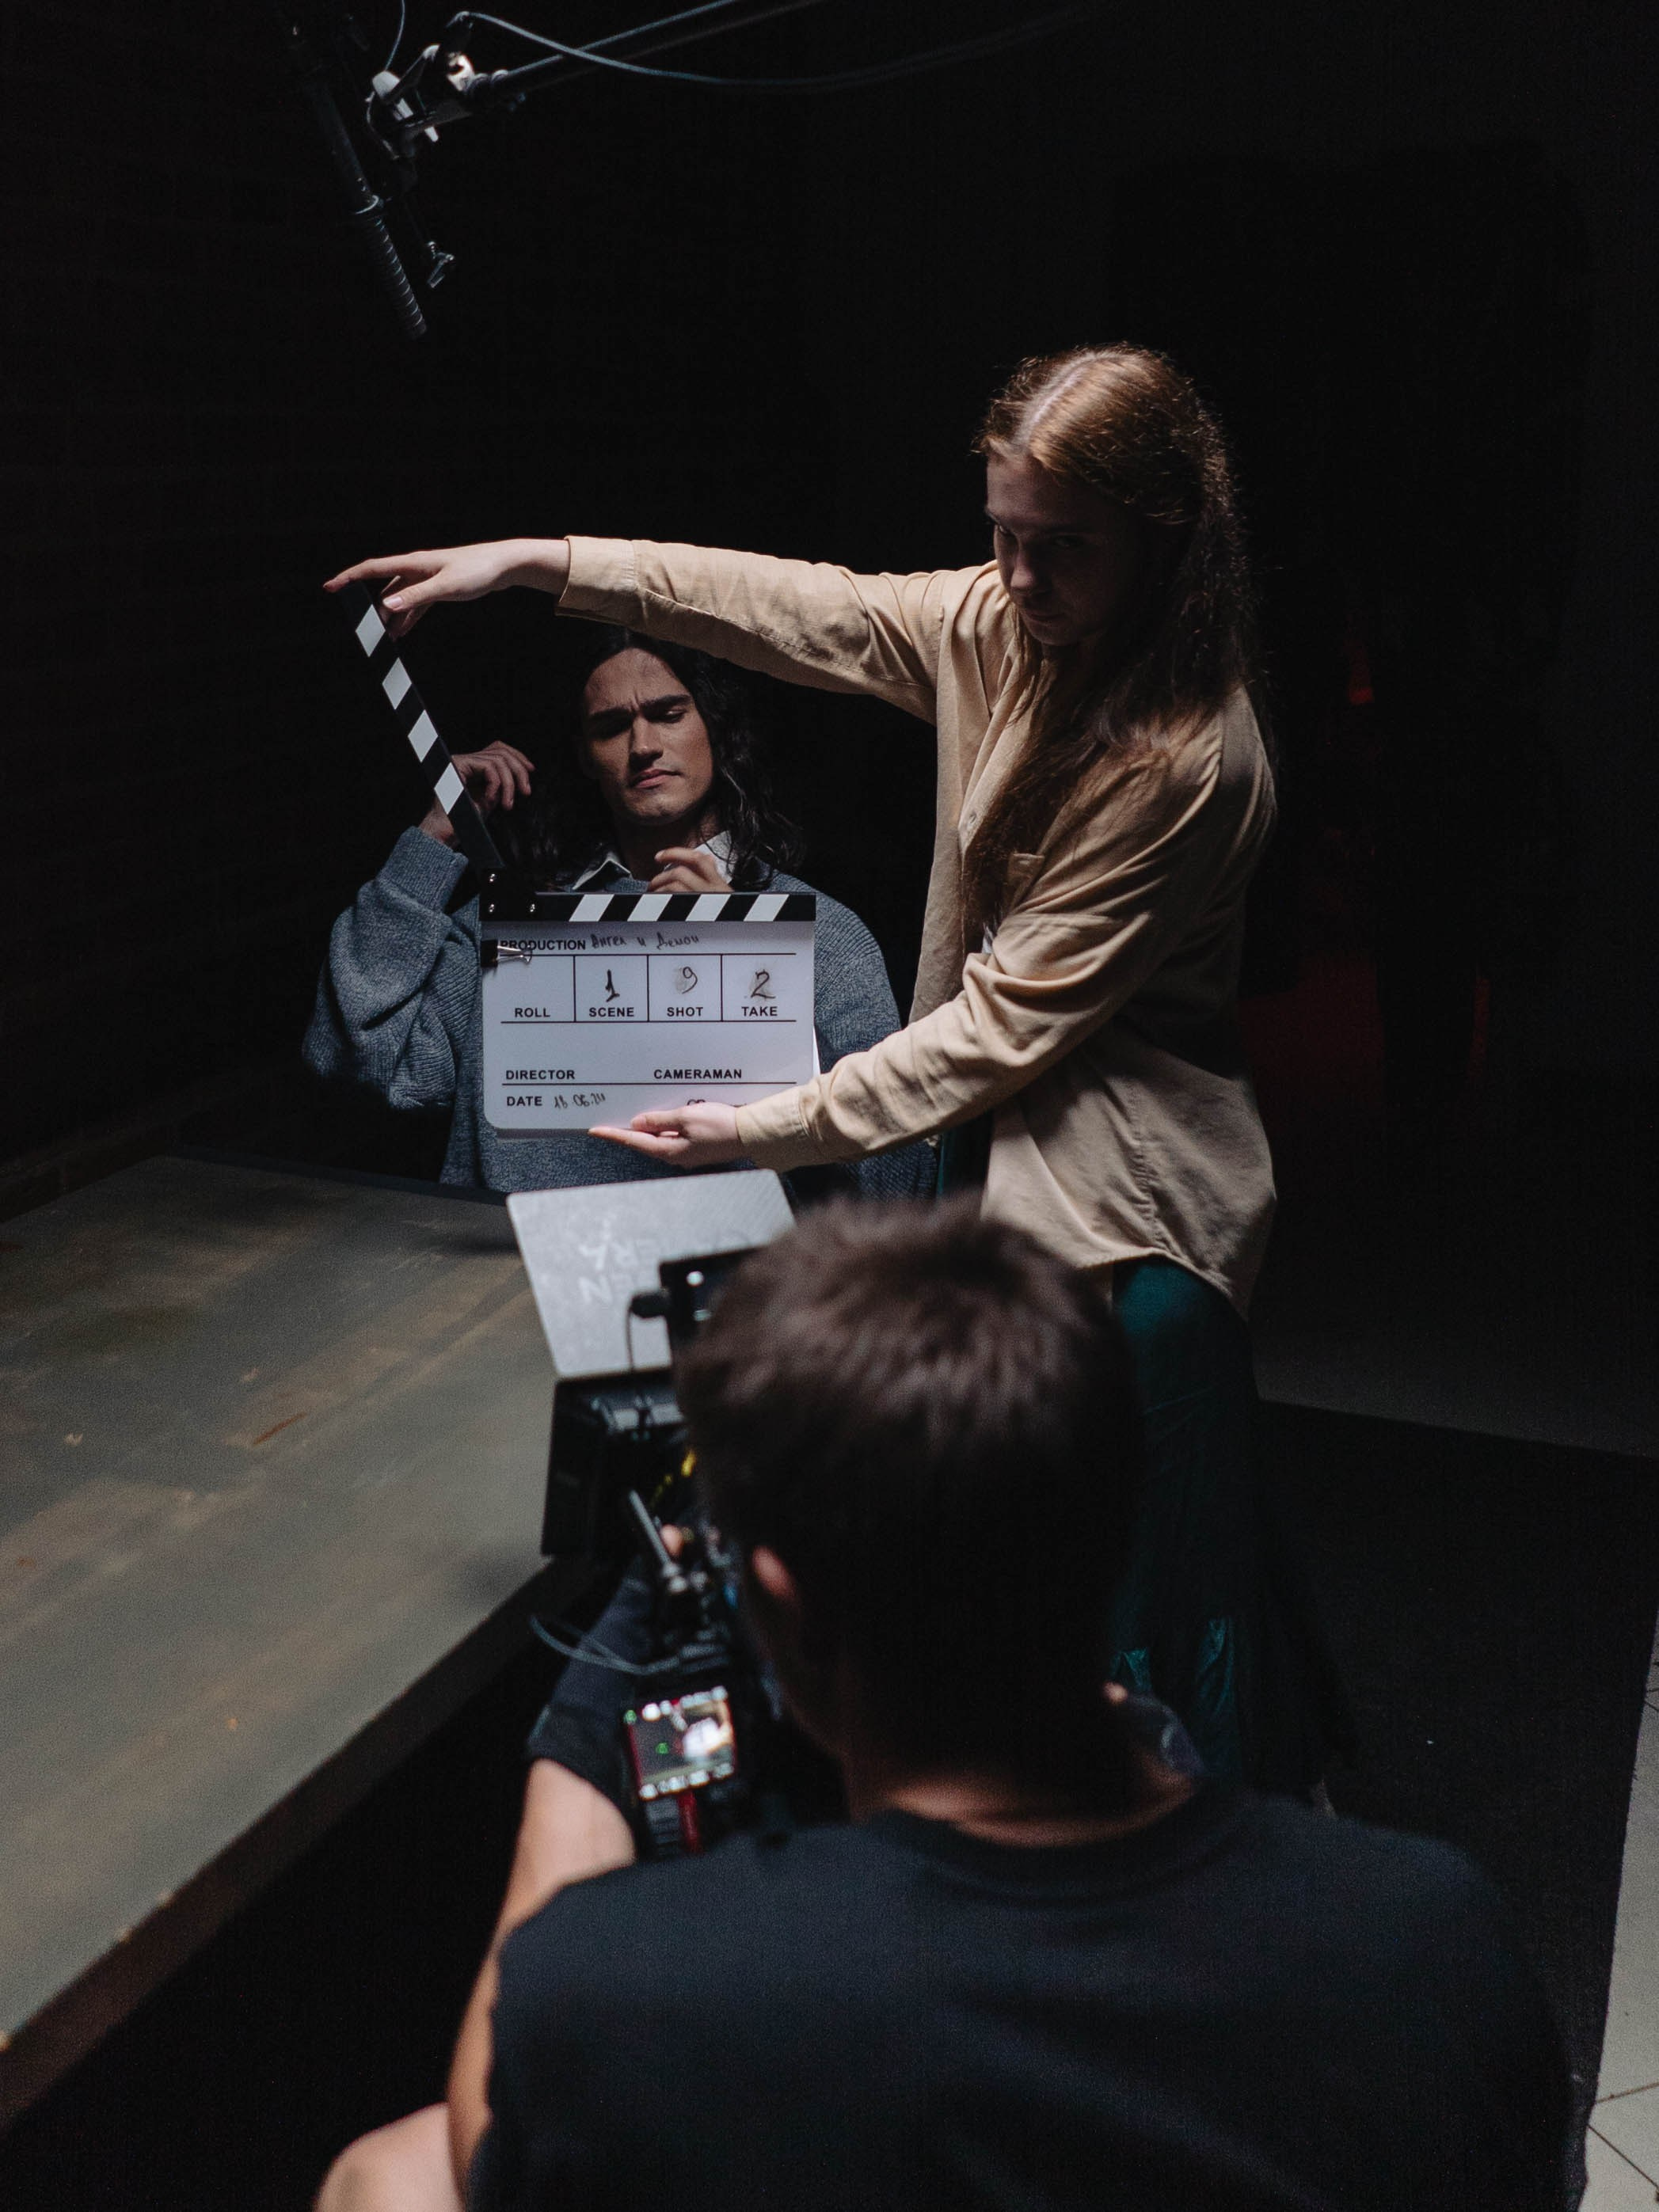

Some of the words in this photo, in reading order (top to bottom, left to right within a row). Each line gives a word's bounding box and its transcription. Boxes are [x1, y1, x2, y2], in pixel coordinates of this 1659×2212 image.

[500, 939, 586, 951] PRODUCTION
[605, 969, 620, 1002] 1
[682, 966, 698, 994] 9
[751, 970, 776, 1000] 2
[515, 1007, 550, 1017] ROLL
[589, 1007, 634, 1017] SCENE
[667, 1006, 703, 1017] SHOT
[741, 1006, 778, 1017] TAKE
[506, 1070, 575, 1080] DIRECTOR
[653, 1069, 742, 1079] CAMERAMAN
[506, 1096, 542, 1106] DATE
